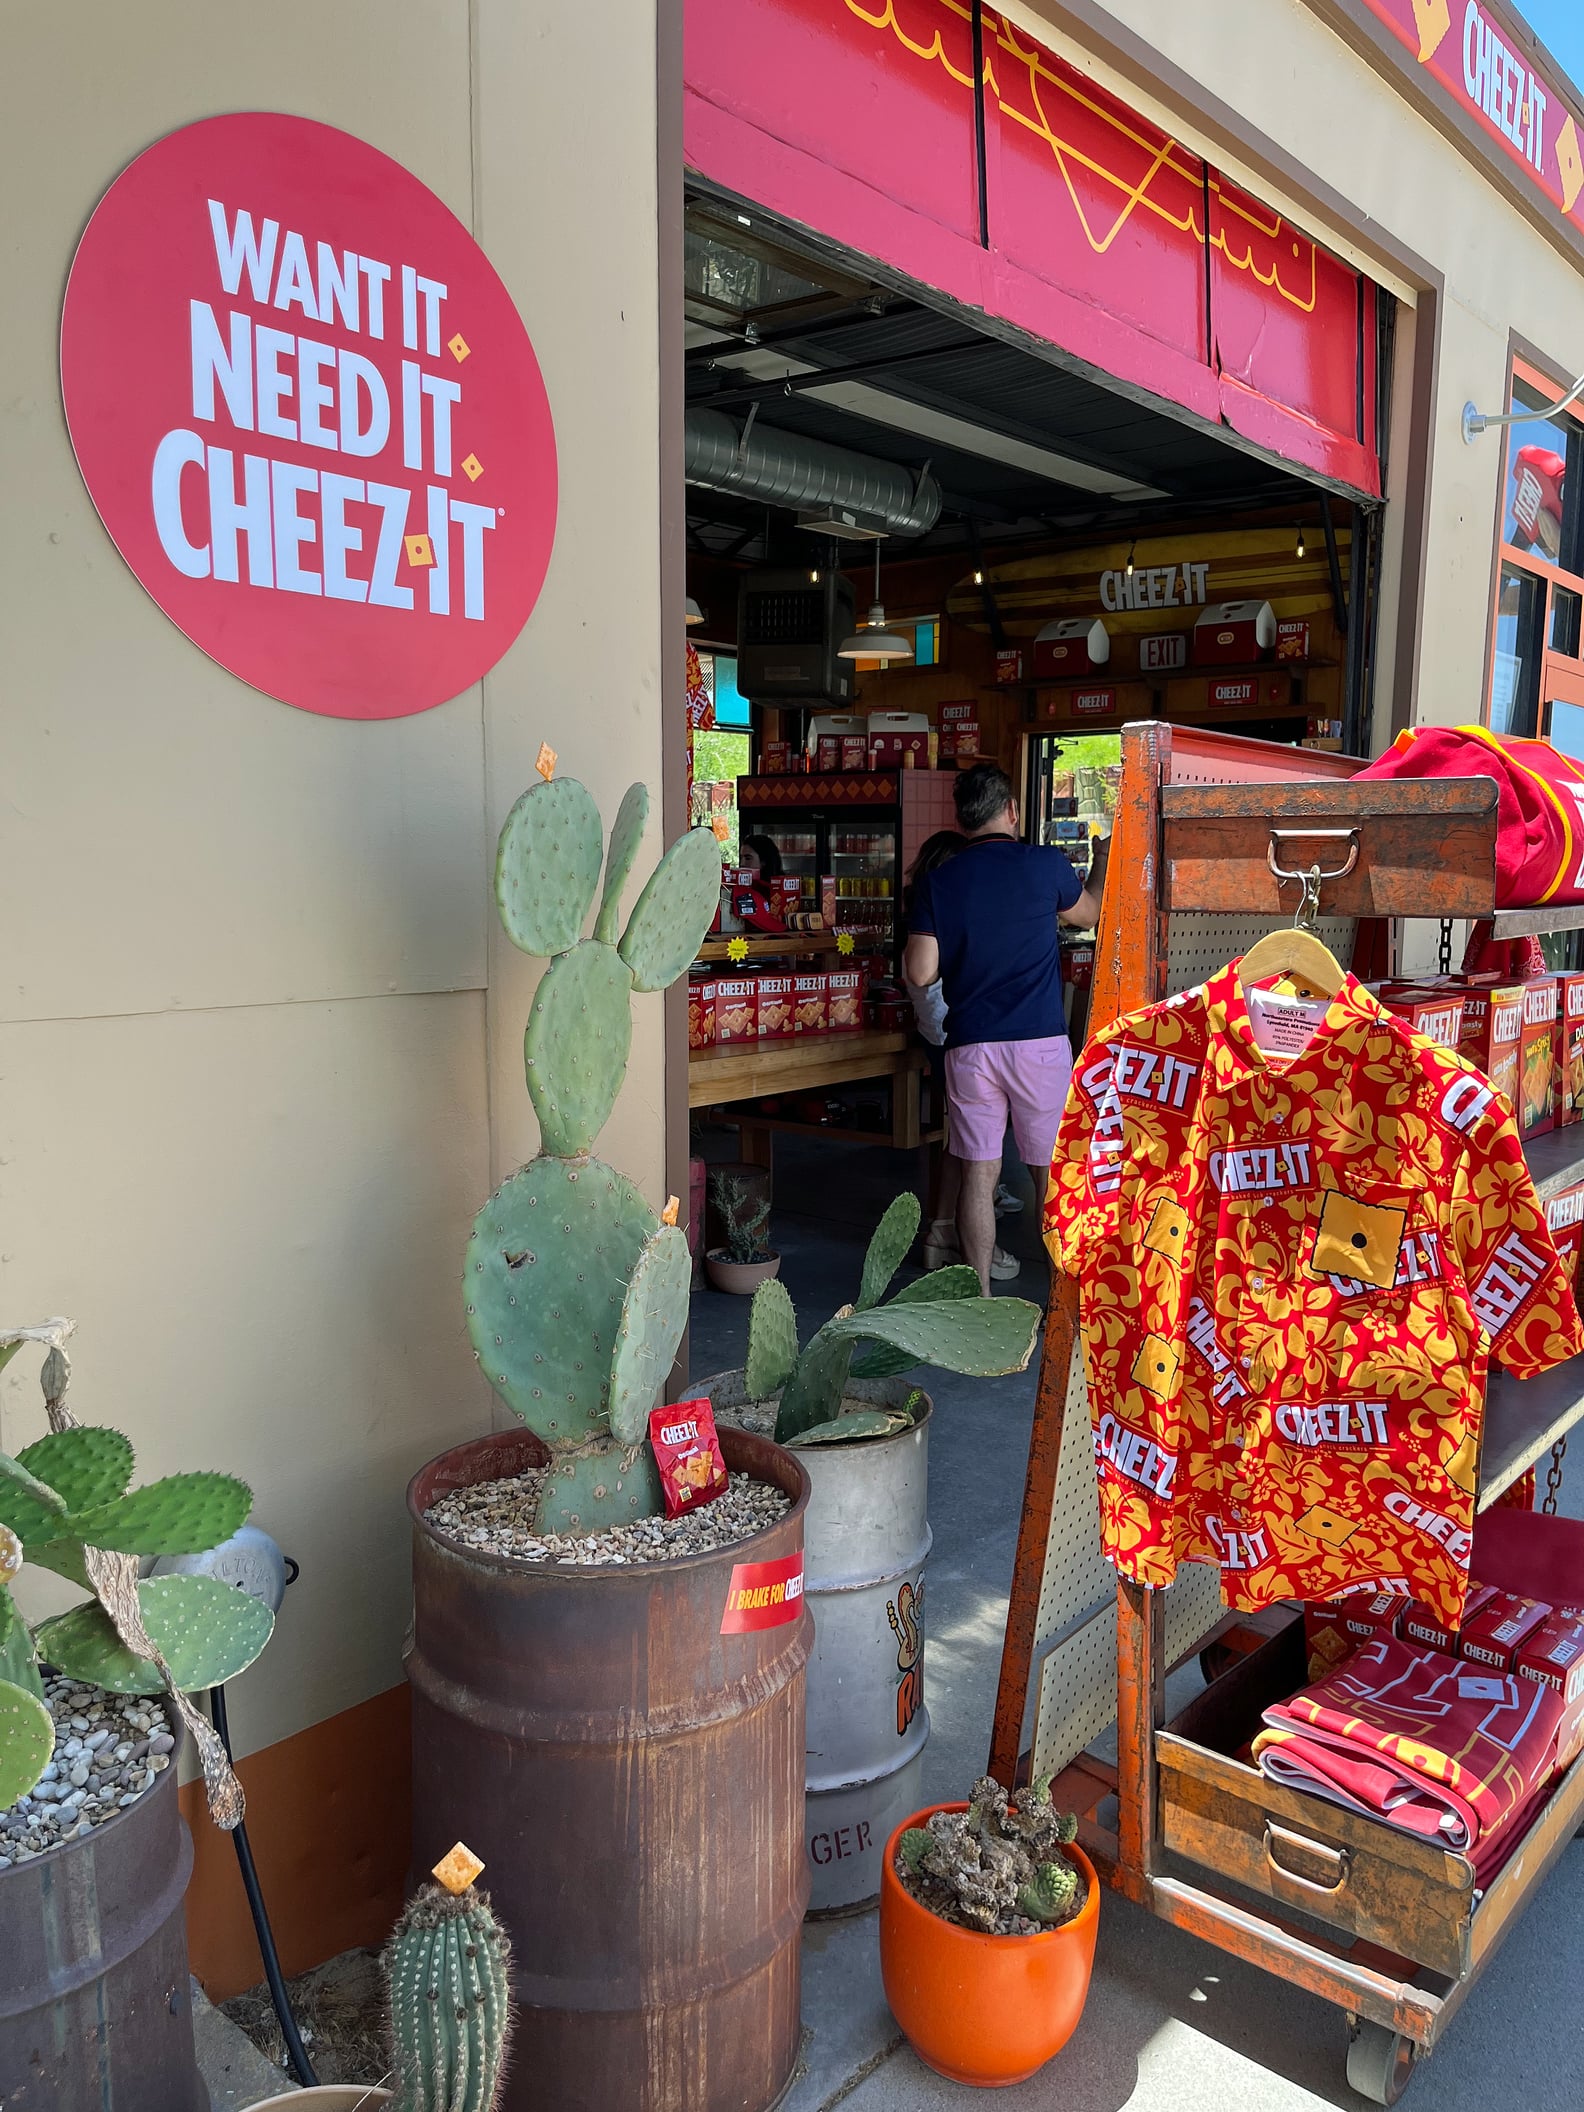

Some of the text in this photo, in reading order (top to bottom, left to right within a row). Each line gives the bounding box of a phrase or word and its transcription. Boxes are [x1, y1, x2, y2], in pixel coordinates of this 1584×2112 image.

[207, 198, 391, 340] WANT
[191, 298, 391, 457] NEED
[1148, 637, 1180, 667] EXIT
[757, 978, 791, 994] HEEZ-IT
[829, 973, 859, 989] HEEZ-IT
[1279, 1009, 1299, 1017] ADULT
[1099, 1412, 1178, 1500] CHEEZ
[1115, 1473, 1129, 1486] aked
[728, 1590, 736, 1611] I
[736, 1585, 771, 1611] BRAKE
[769, 1582, 786, 1606] FOR
[1346, 1619, 1373, 1636] CHEEZ
[810, 1820, 873, 1865] GER
